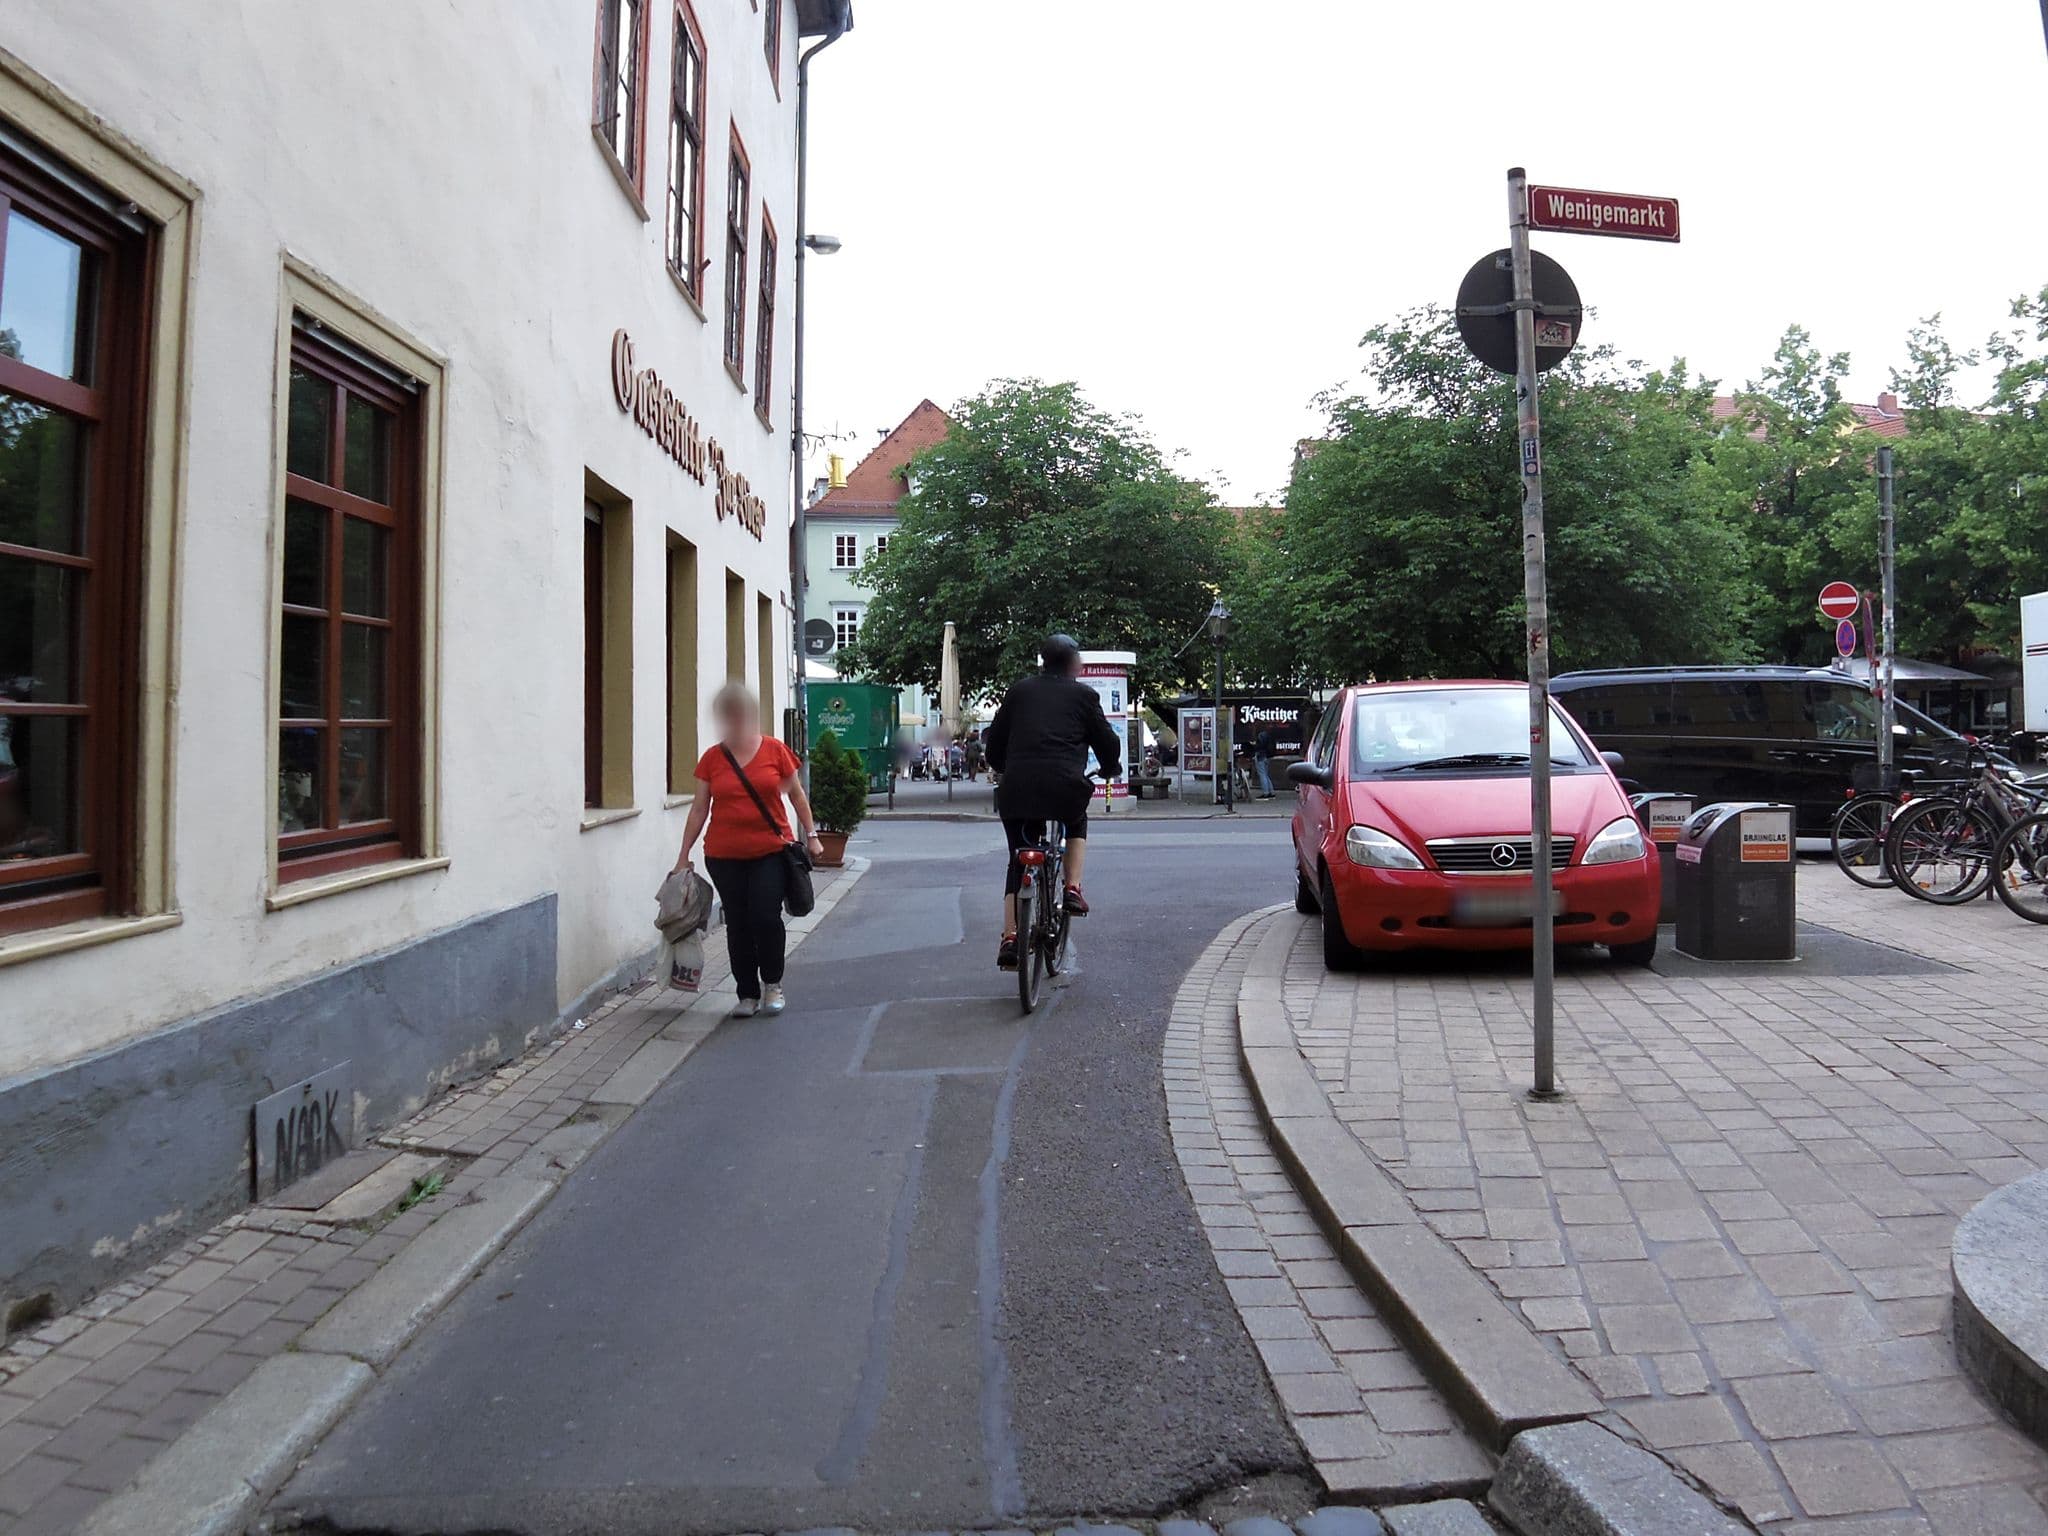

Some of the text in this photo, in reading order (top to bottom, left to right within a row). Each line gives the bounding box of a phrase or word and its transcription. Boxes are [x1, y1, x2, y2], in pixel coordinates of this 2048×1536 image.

[1548, 194, 1665, 228] Wenigemarkt
[1239, 705, 1299, 724] Köstritzer
[1743, 833, 1787, 842] BRAUNGLAS
